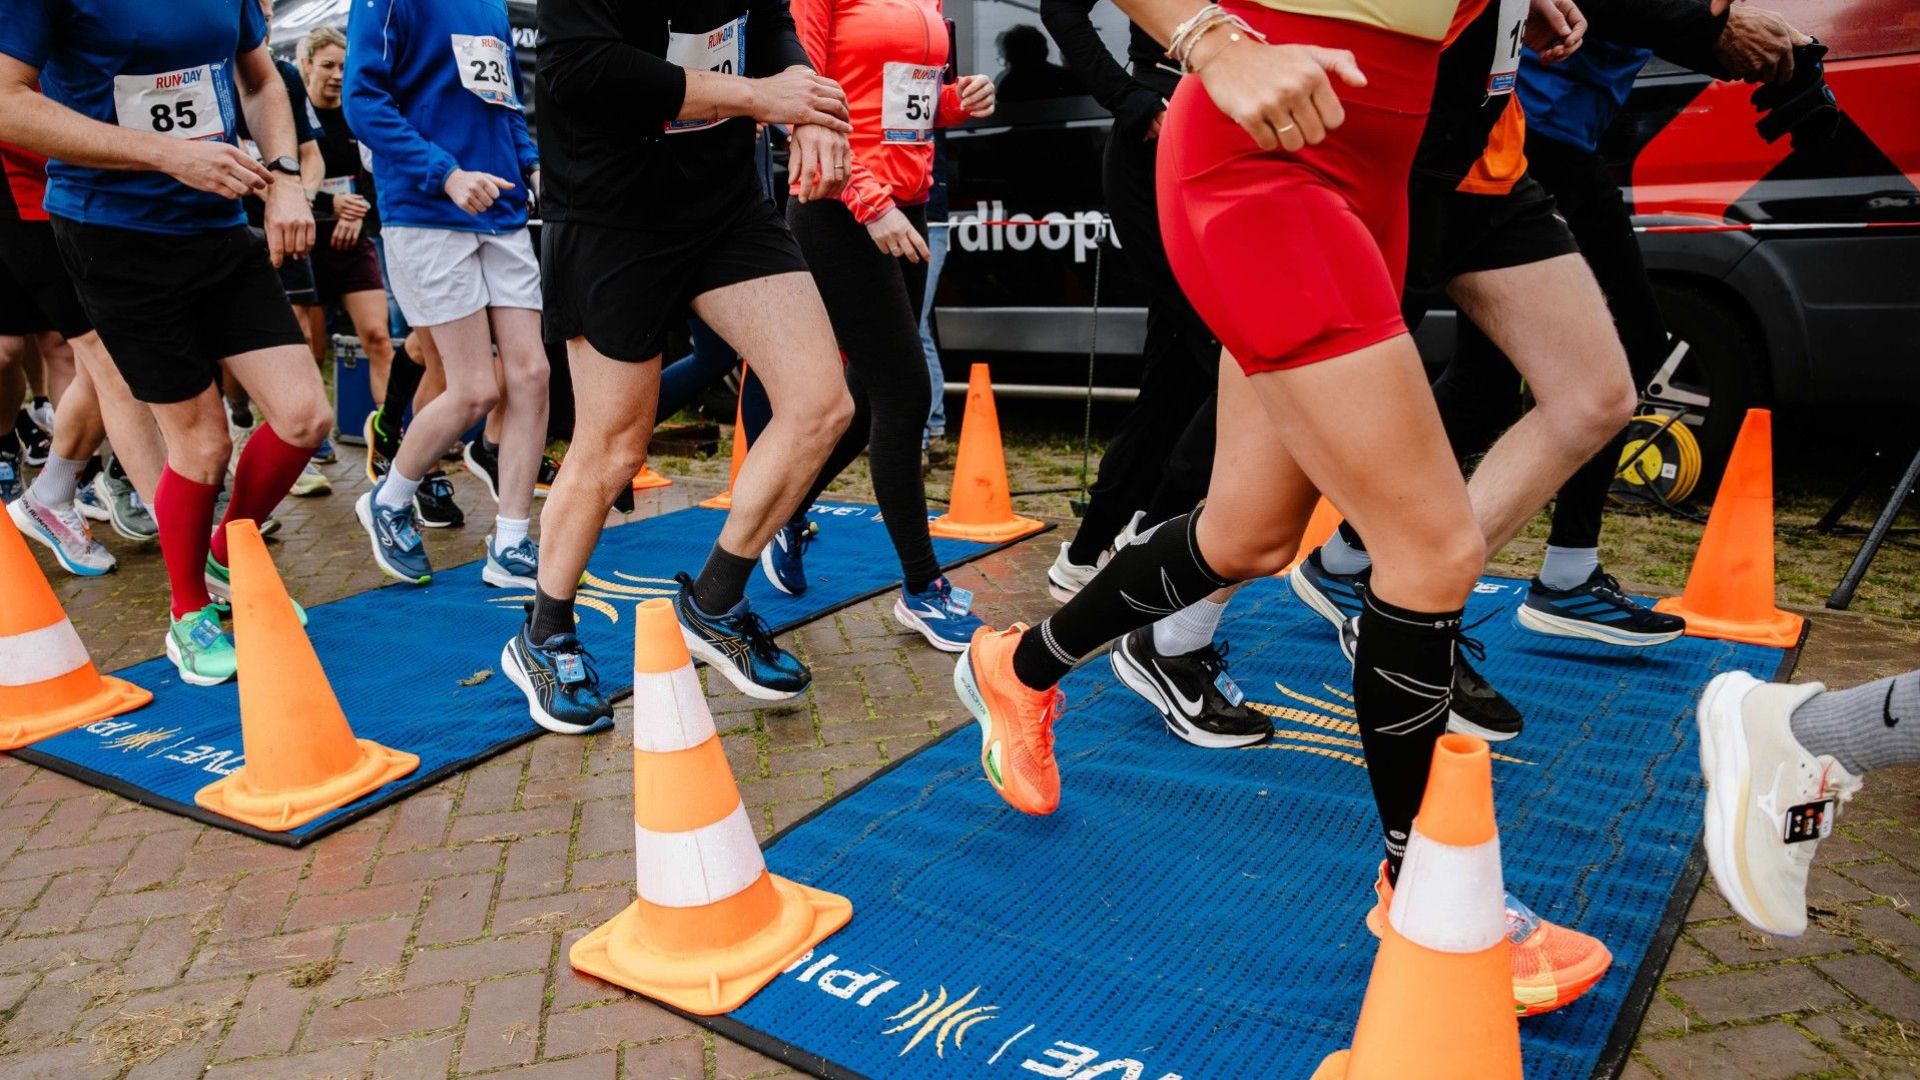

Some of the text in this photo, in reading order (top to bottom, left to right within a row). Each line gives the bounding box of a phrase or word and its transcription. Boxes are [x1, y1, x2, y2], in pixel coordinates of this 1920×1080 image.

[150, 100, 198, 132] 85
[905, 94, 930, 120] 53
[1020, 1040, 1183, 1080] VE
